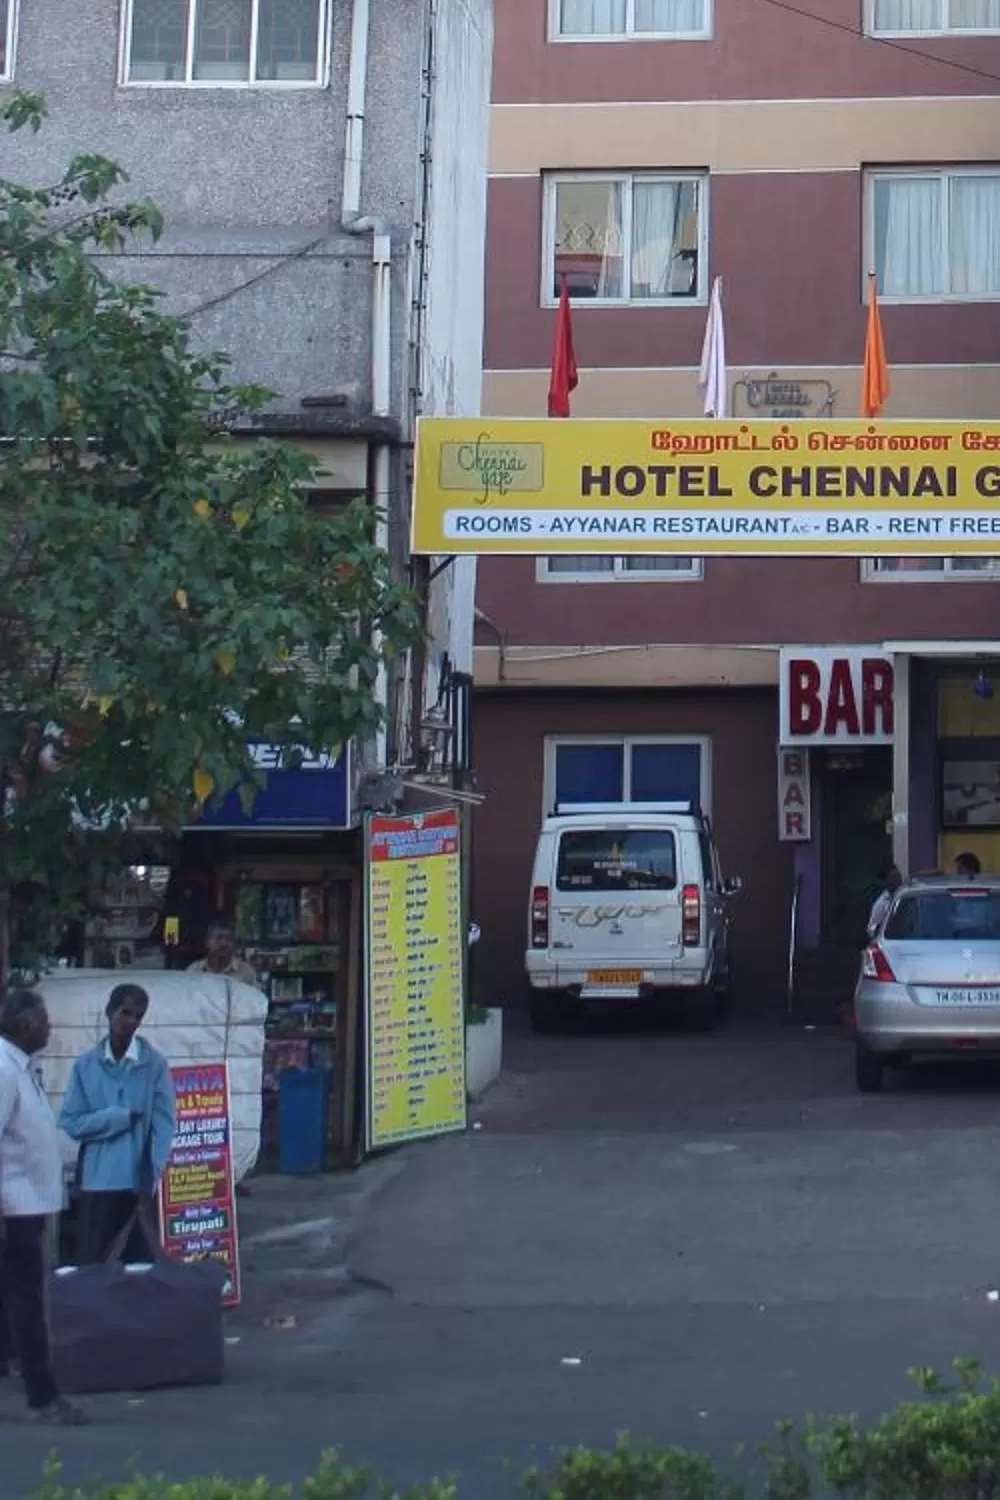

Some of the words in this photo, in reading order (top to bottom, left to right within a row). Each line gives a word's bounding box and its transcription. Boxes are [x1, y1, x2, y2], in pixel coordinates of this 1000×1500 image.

[651, 425, 799, 457] ஹோட்டல்
[807, 426, 952, 452] சென்னை
[580, 465, 733, 498] HOTEL
[748, 465, 957, 498] CHENNAI
[455, 516, 532, 534] ROOMS
[549, 517, 646, 534] AYYANAR
[653, 517, 792, 534] RESTAURANT
[826, 518, 870, 534] BAR
[888, 518, 942, 534] RENT
[788, 658, 895, 737] BAR
[784, 753, 804, 836] BAR
[174, 1216, 224, 1234] Tirupati
